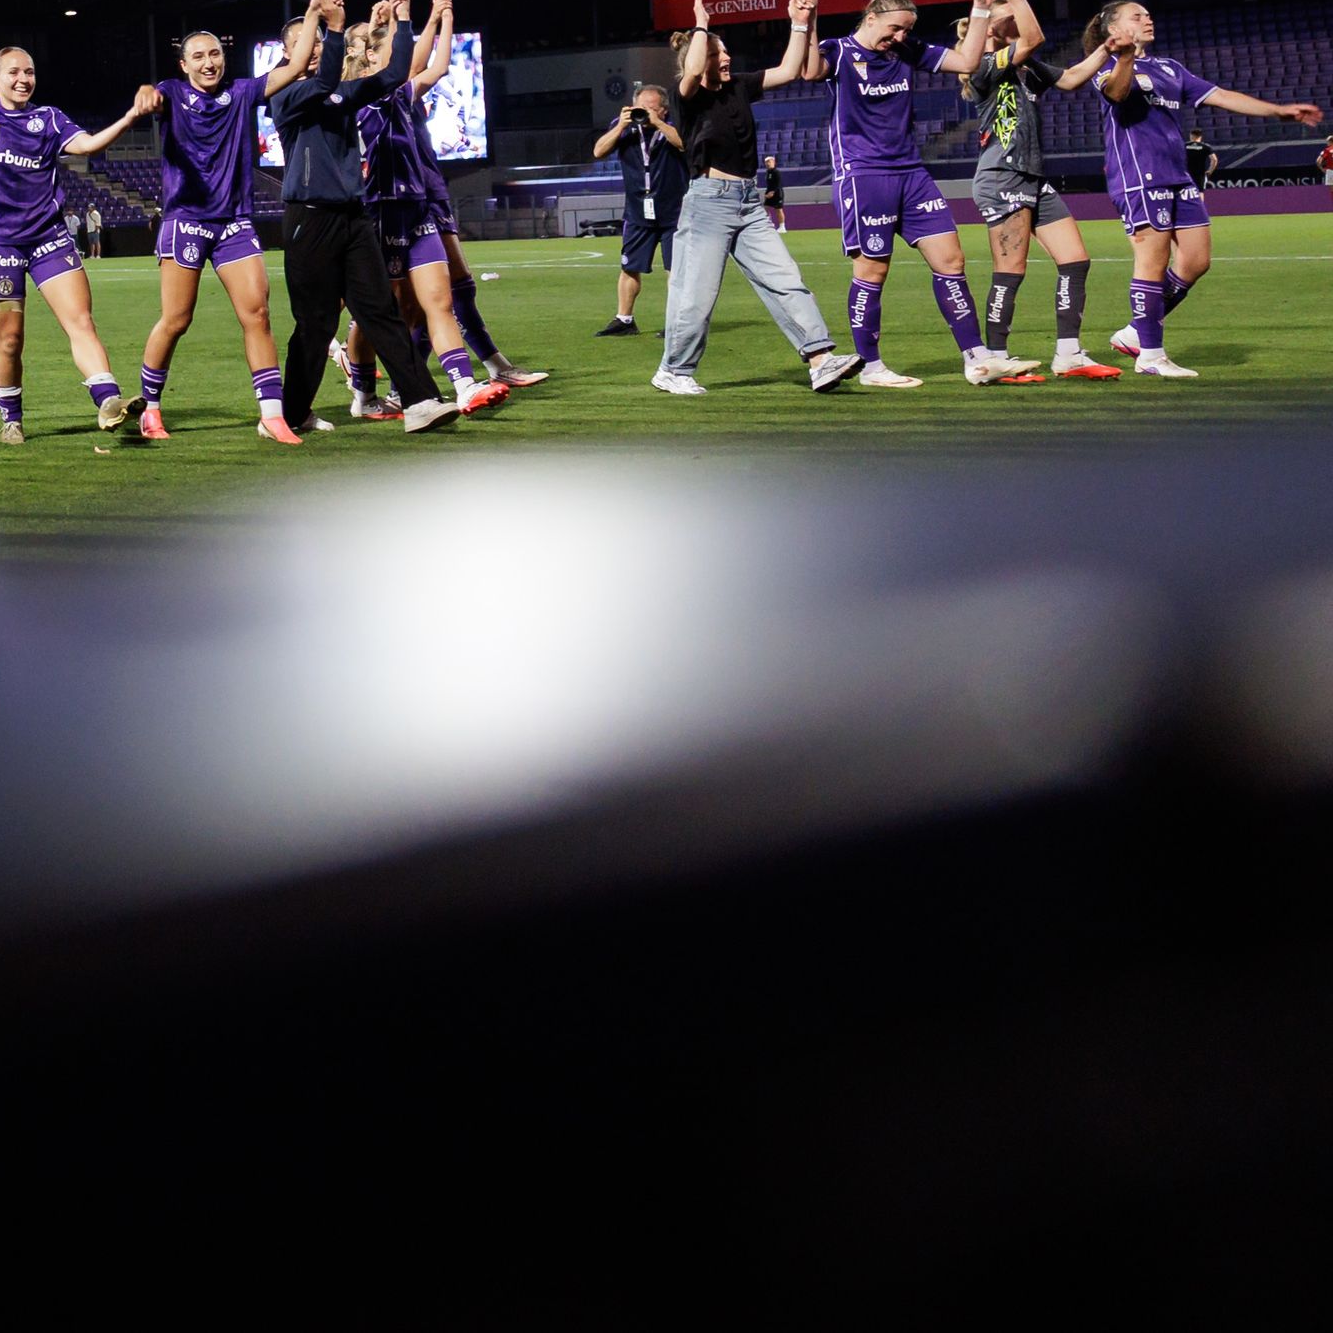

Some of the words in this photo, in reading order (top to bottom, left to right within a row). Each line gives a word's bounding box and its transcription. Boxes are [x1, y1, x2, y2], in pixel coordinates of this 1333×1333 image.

[858, 79, 910, 97] Verbund
[923, 198, 947, 213] VIE
[987, 284, 1009, 324] Verbund
[1132, 292, 1147, 320] Verb
